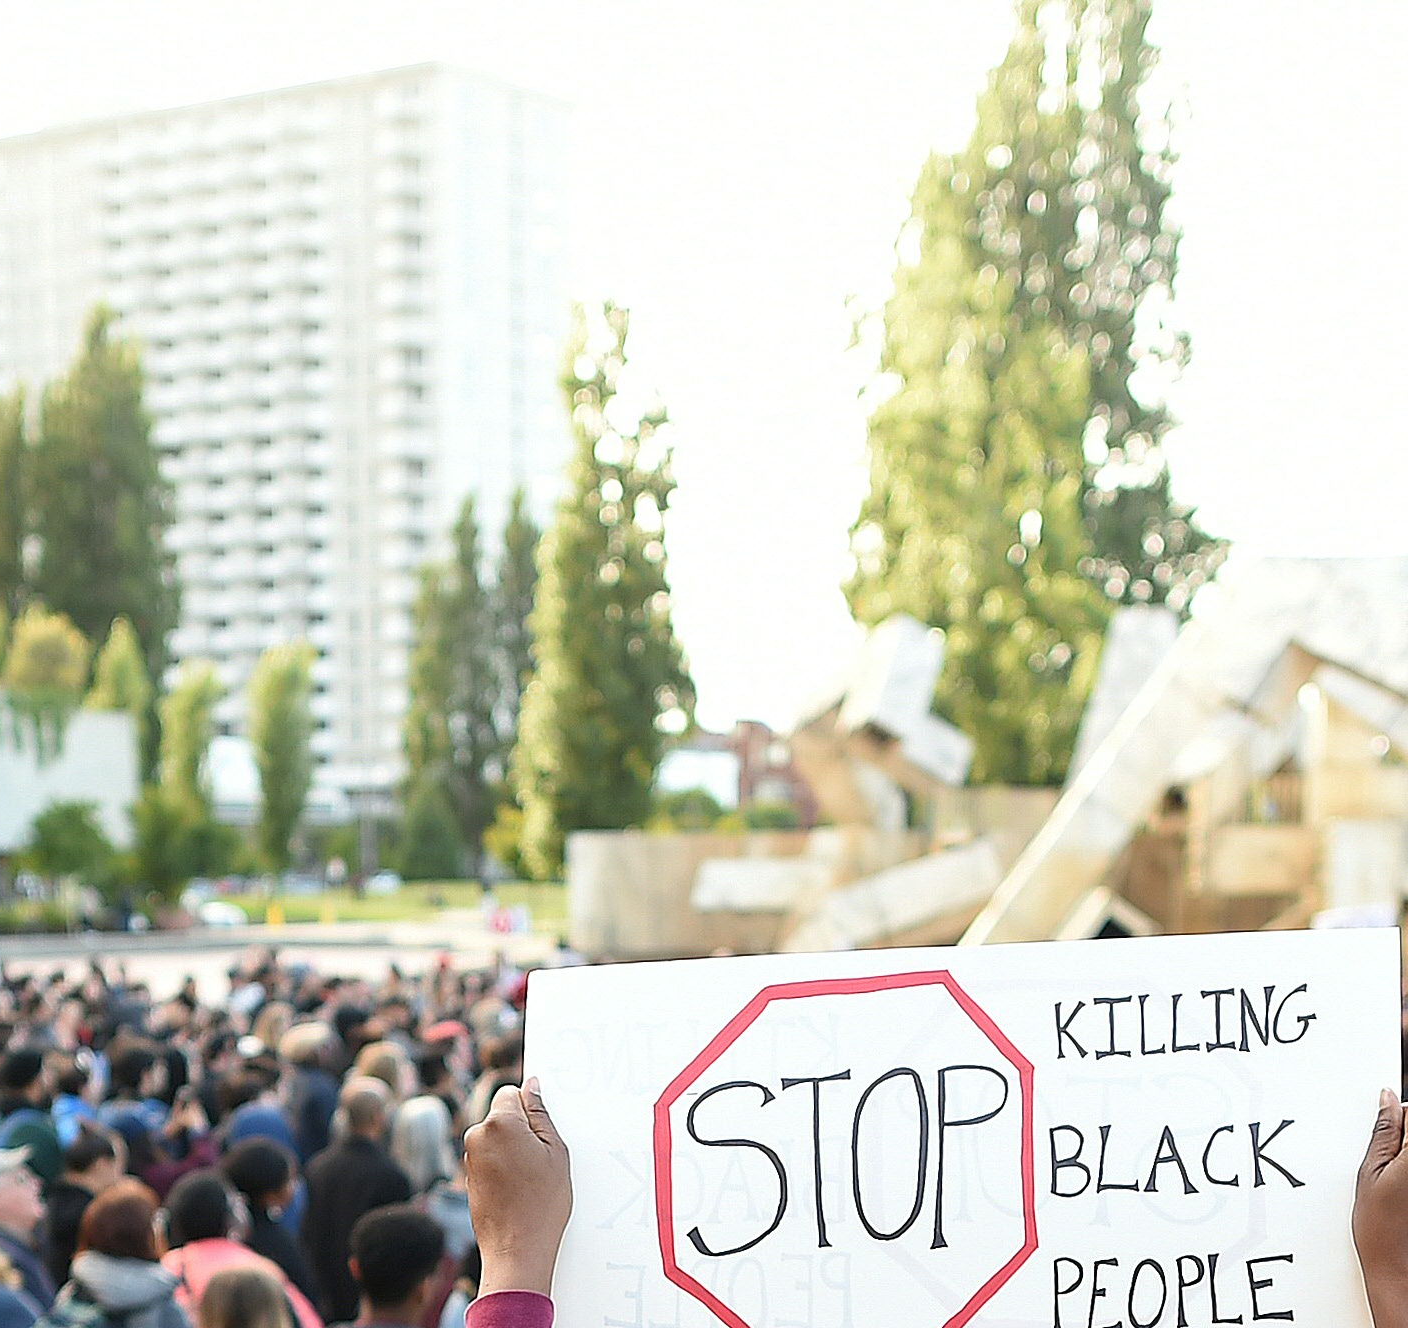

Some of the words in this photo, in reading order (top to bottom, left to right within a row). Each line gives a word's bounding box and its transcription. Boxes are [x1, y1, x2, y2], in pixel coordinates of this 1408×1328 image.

[1054, 983, 1318, 1062] KILLING
[686, 1064, 1010, 1257] STOP
[1049, 1118, 1307, 1199] BLACK
